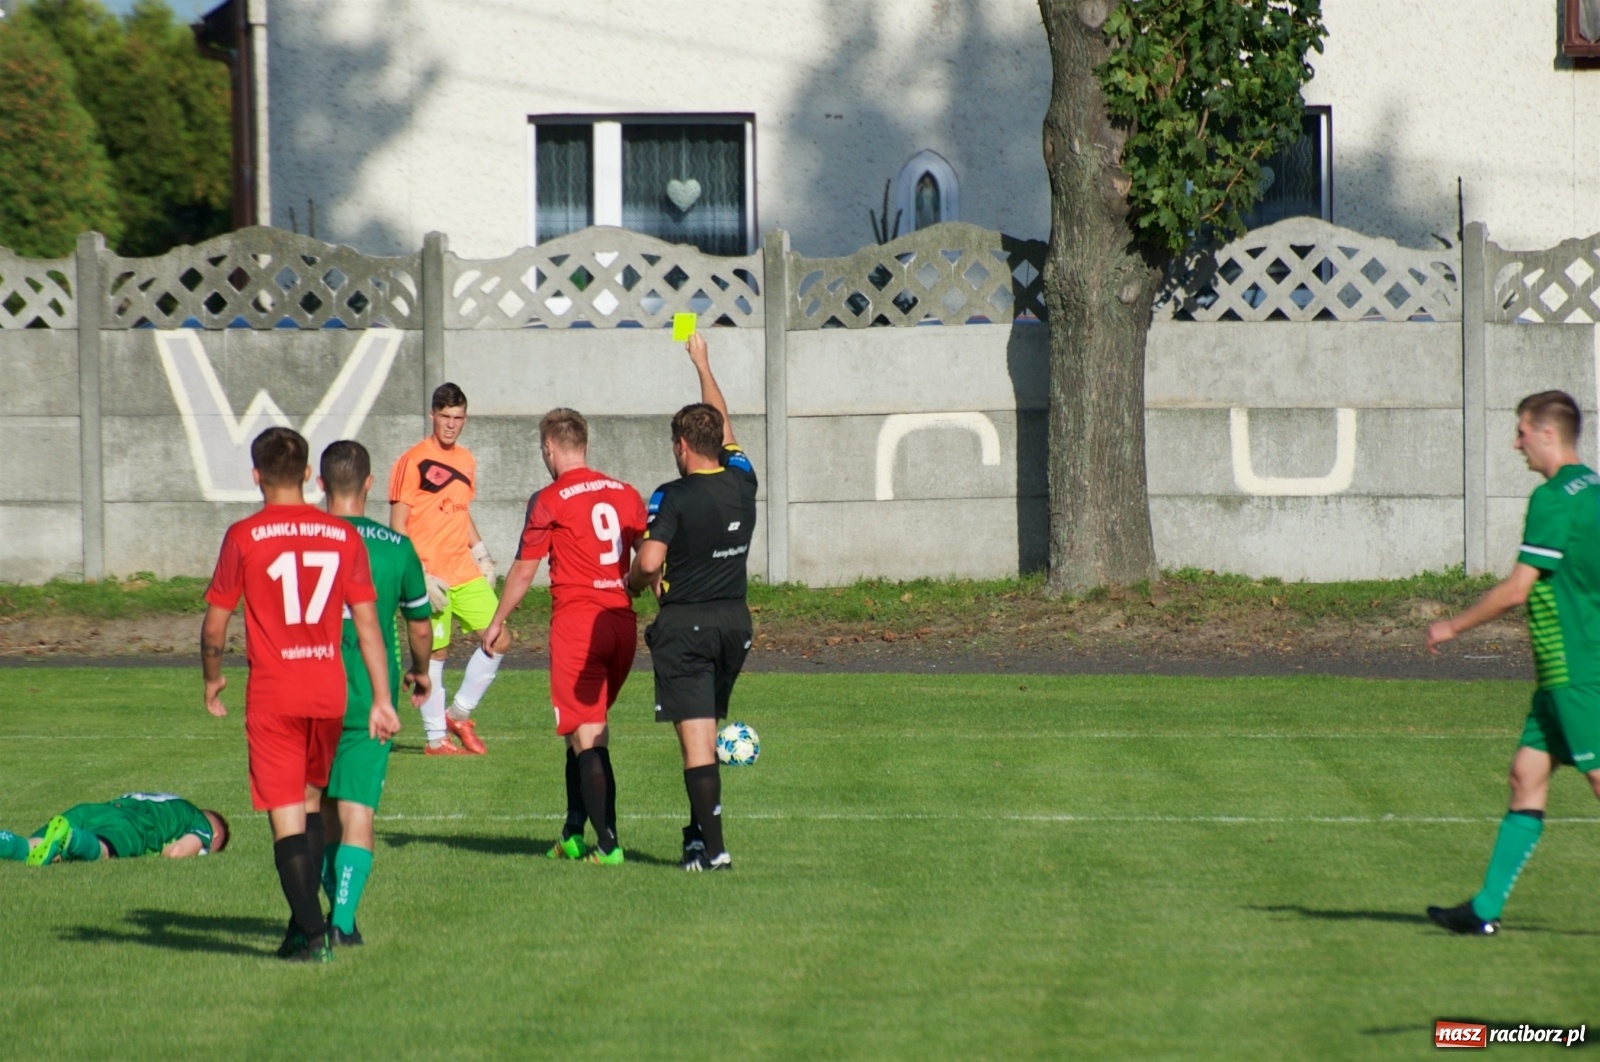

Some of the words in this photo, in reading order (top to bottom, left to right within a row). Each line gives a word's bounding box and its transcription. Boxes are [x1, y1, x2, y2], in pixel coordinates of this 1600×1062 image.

[251, 522, 298, 542] GRANICA
[299, 522, 347, 543] RUPTAWA
[591, 502, 623, 566] 9
[266, 551, 340, 626] 17
